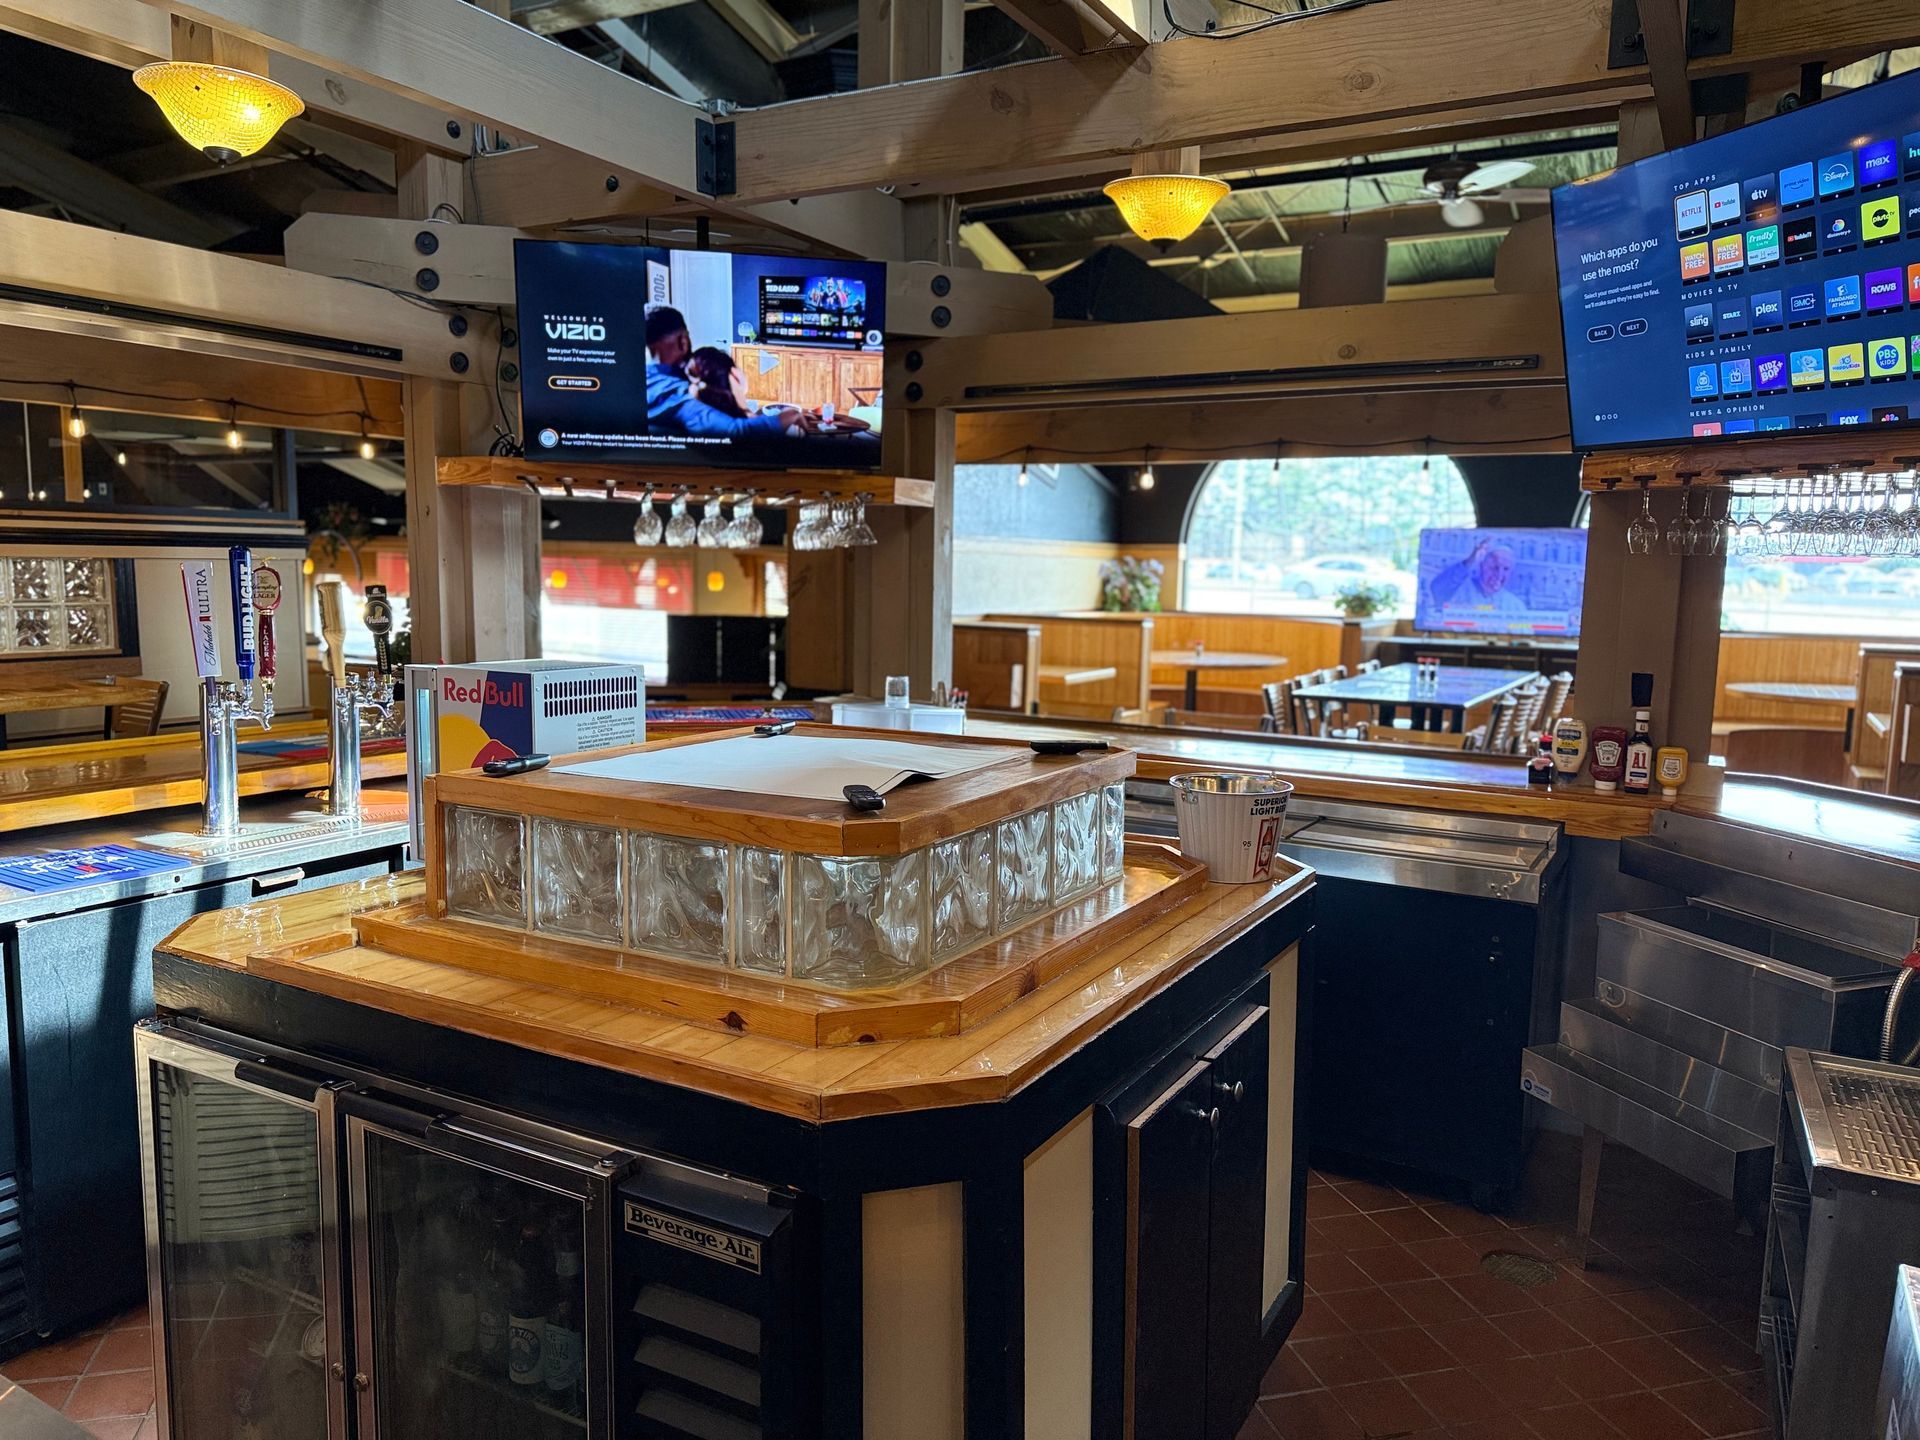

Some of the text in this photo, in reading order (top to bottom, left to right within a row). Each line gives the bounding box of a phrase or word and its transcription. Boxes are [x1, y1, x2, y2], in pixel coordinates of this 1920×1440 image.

[1865, 154, 1890, 169] max
[1673, 174, 1717, 192] TOP APPS
[1681, 206, 1702, 218] NETFLIX
[1580, 238, 1658, 265] Which apps do you
[1717, 243, 1738, 254] WATCH
[1684, 252, 1705, 263] WATCH
[1582, 258, 1640, 282] use the most?
[1583, 291, 1597, 300] Select
[1597, 290, 1607, 299] your
[1631, 283, 1643, 291] apps
[1681, 288, 1713, 300] MOVIES
[1727, 283, 1738, 291] TV
[1594, 299, 1607, 307] make
[1632, 292, 1643, 300] easy
[1828, 294, 1857, 304] FANDANGO
[1755, 303, 1778, 317] plex
[543, 314, 587, 322] WELCOME
[1689, 315, 1709, 327] sling
[545, 322, 606, 341] VIZIO
[1626, 323, 1640, 331] NEXT
[1685, 350, 1705, 360] KIDS
[1719, 344, 1752, 354] FAMILY
[1877, 348, 1897, 360] PBS
[1880, 358, 1896, 367] KIDS
[568, 379, 592, 387] STARTED
[1689, 408, 1714, 418] NEWS
[1726, 404, 1765, 414] OPINION
[195, 568, 210, 616] ULTRA
[242, 614, 255, 651] BUD
[202, 624, 216, 666] Michelob
[443, 677, 525, 708] Red Bull
[1253, 795, 1288, 807] SUPERIOR
[1250, 806, 1275, 816] LIGHT
[1242, 840, 1252, 848] 95
